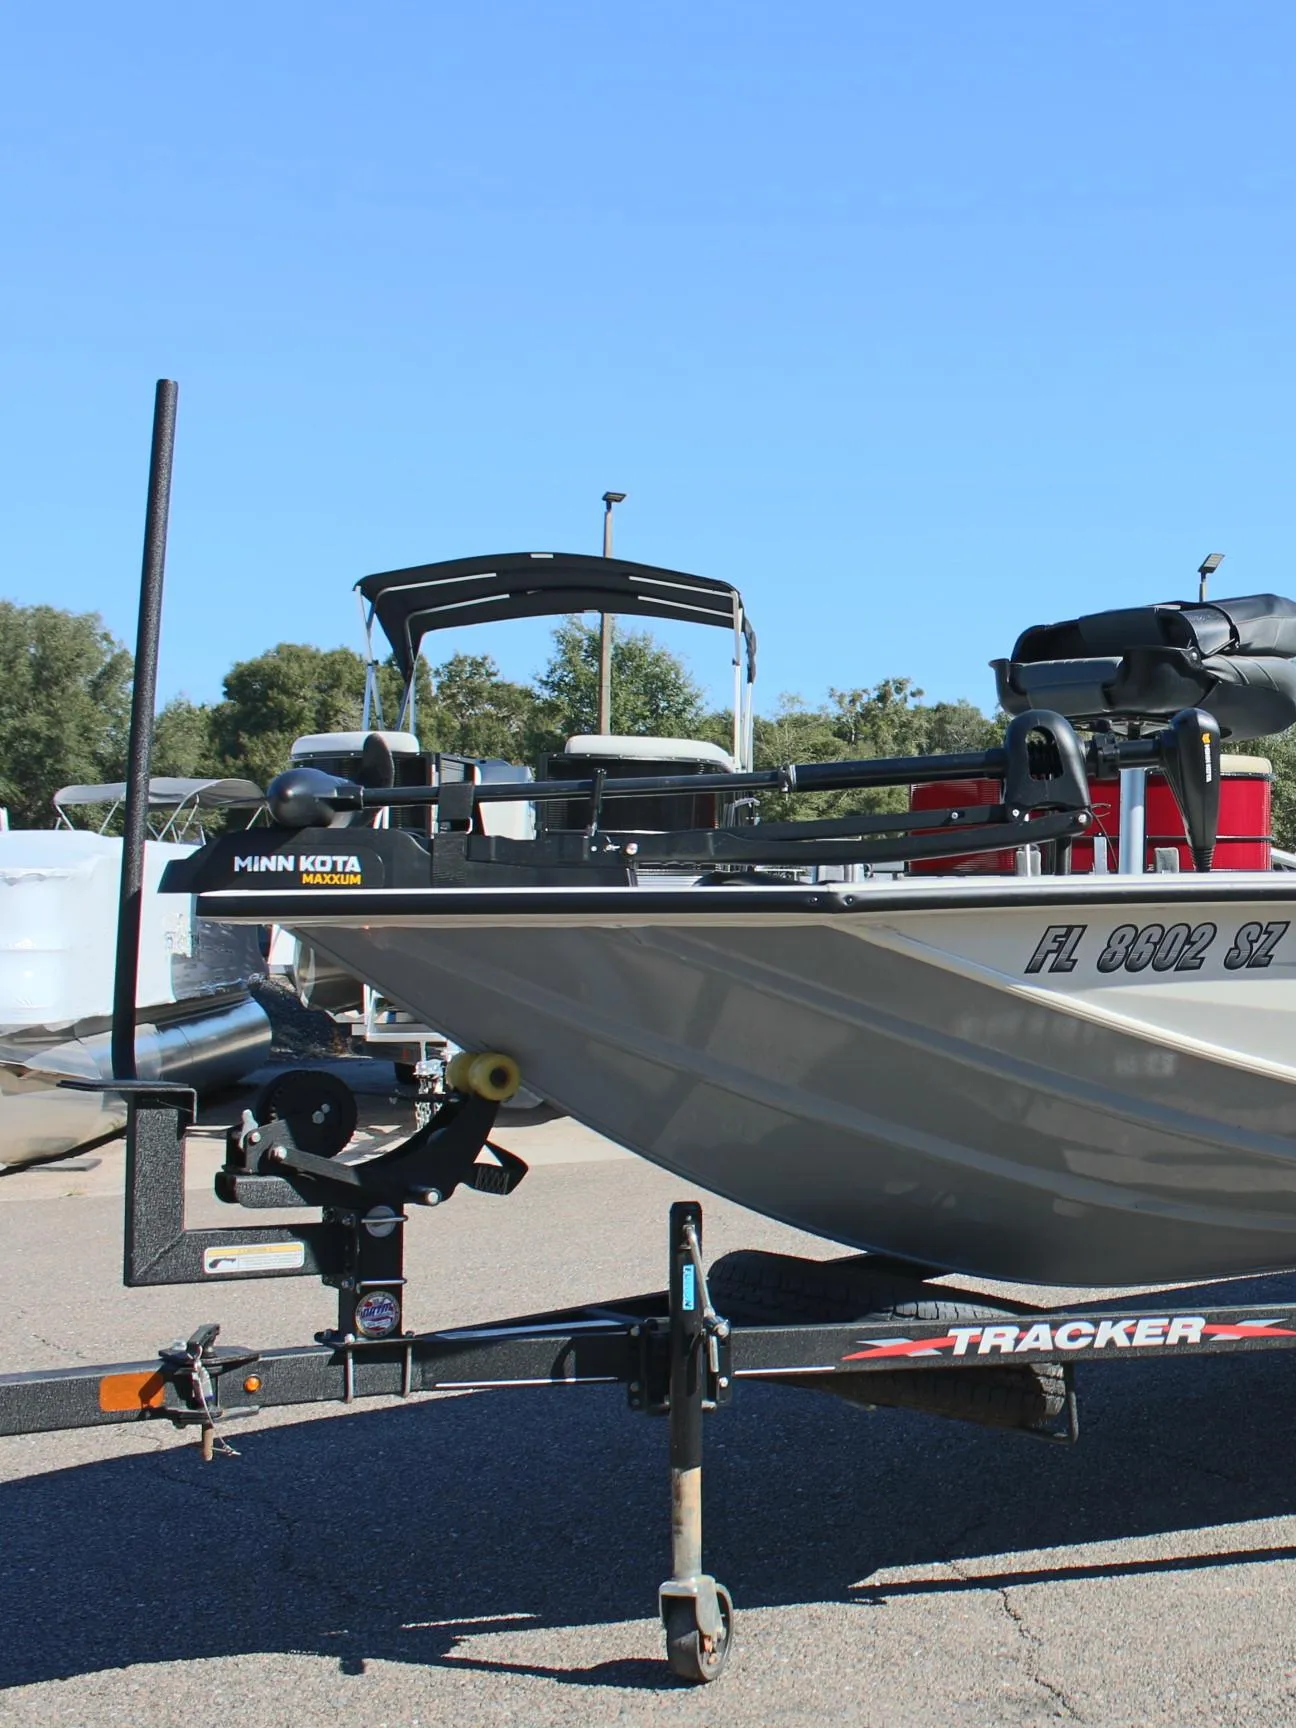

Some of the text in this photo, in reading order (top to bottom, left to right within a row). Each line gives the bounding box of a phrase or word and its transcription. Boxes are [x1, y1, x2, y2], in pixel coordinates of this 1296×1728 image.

[234, 855, 362, 872] MINN KOTA
[302, 873, 361, 885] MAXXUM
[1024, 920, 1291, 974] FL 8602 SZ
[947, 1317, 1206, 1356] TRACKER
